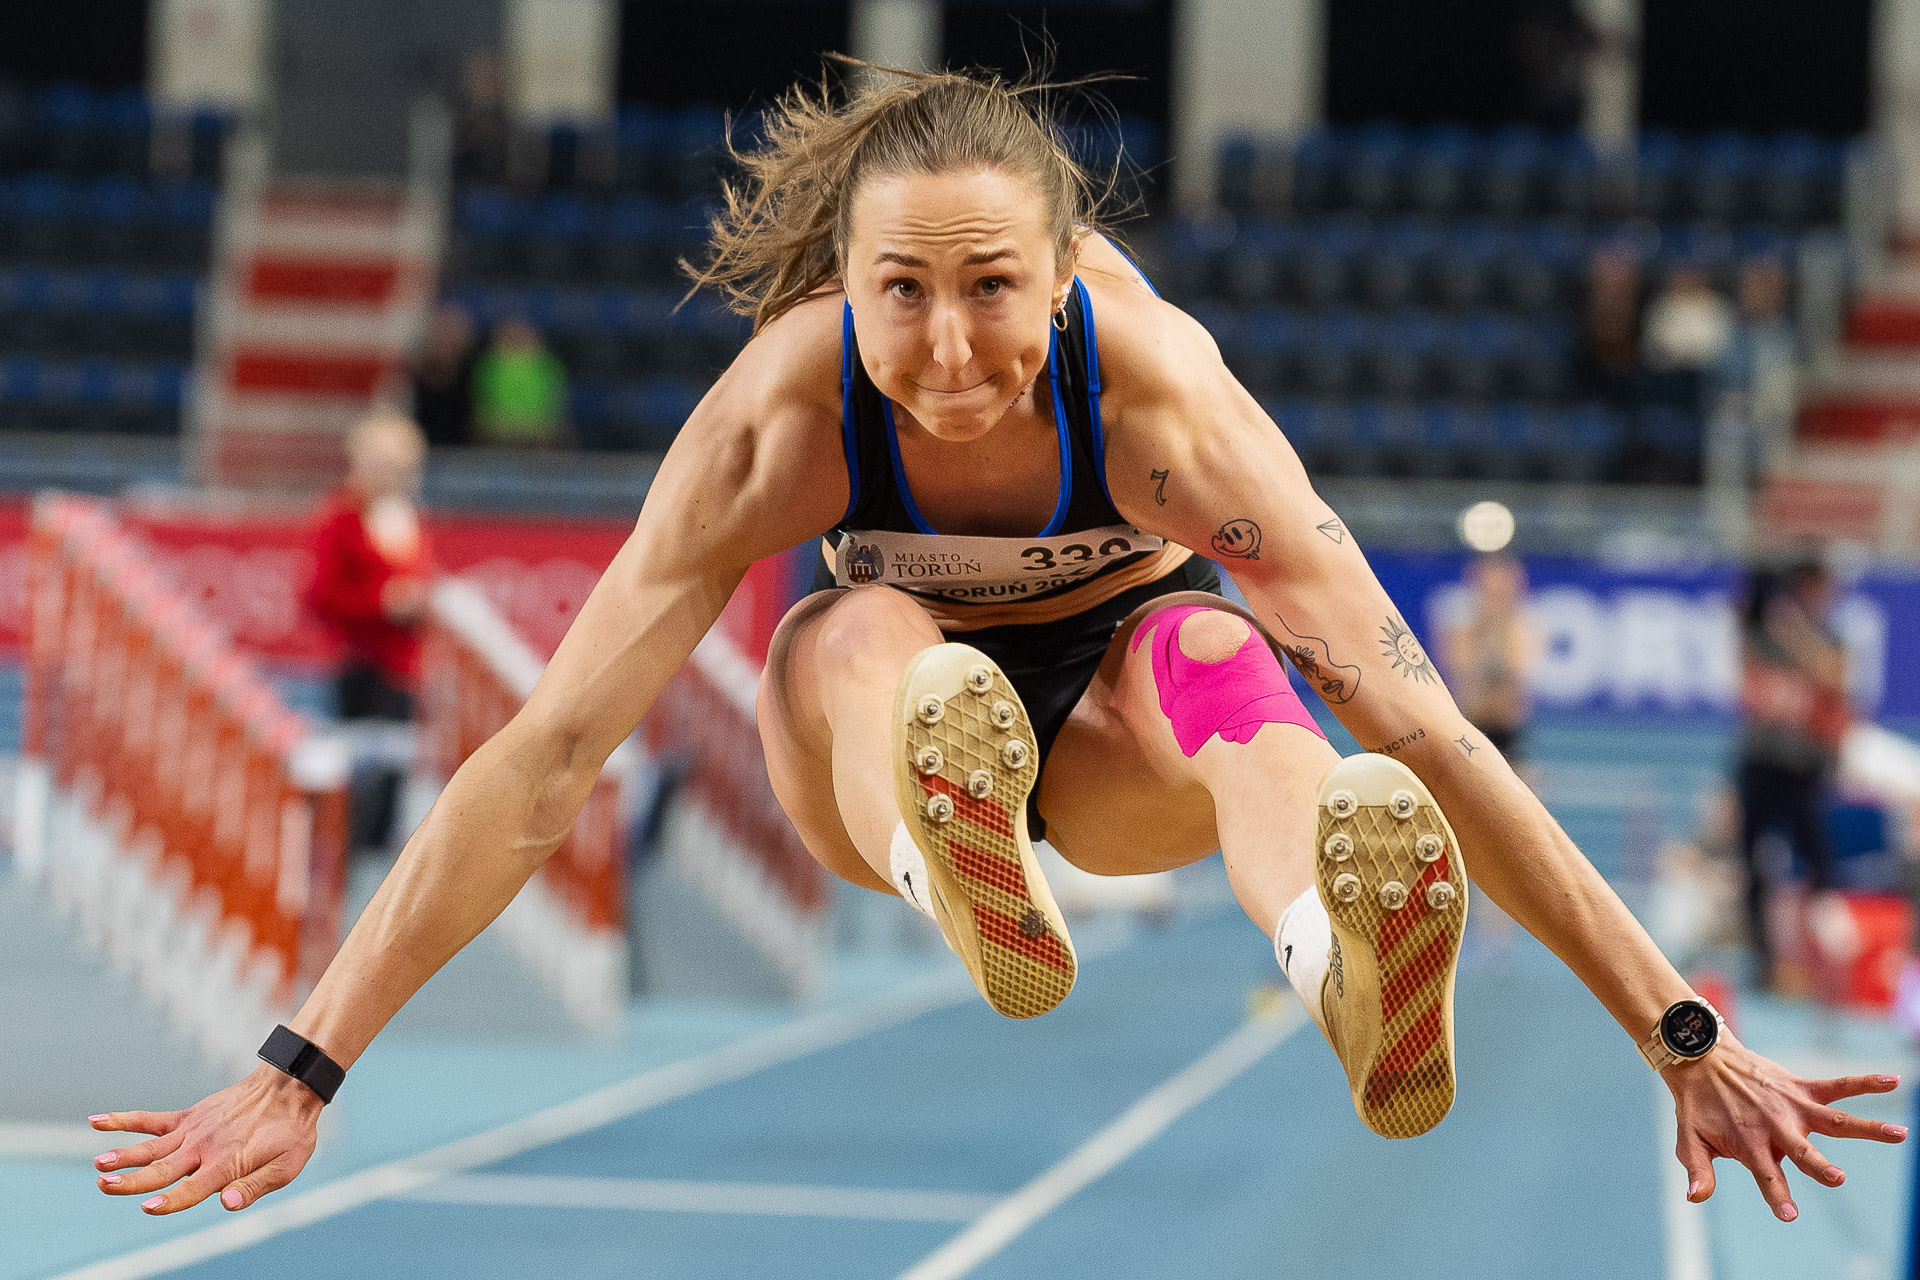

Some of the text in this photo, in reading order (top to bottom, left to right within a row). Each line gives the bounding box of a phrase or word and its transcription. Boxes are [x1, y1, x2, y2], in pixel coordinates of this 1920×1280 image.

[895, 553, 961, 562] MIASTO
[892, 559, 981, 578] TORUŃ
[932, 580, 1028, 598] TORUŃ
[1685, 1011, 1702, 1030] 18
[1676, 1028, 1699, 1046] 27
